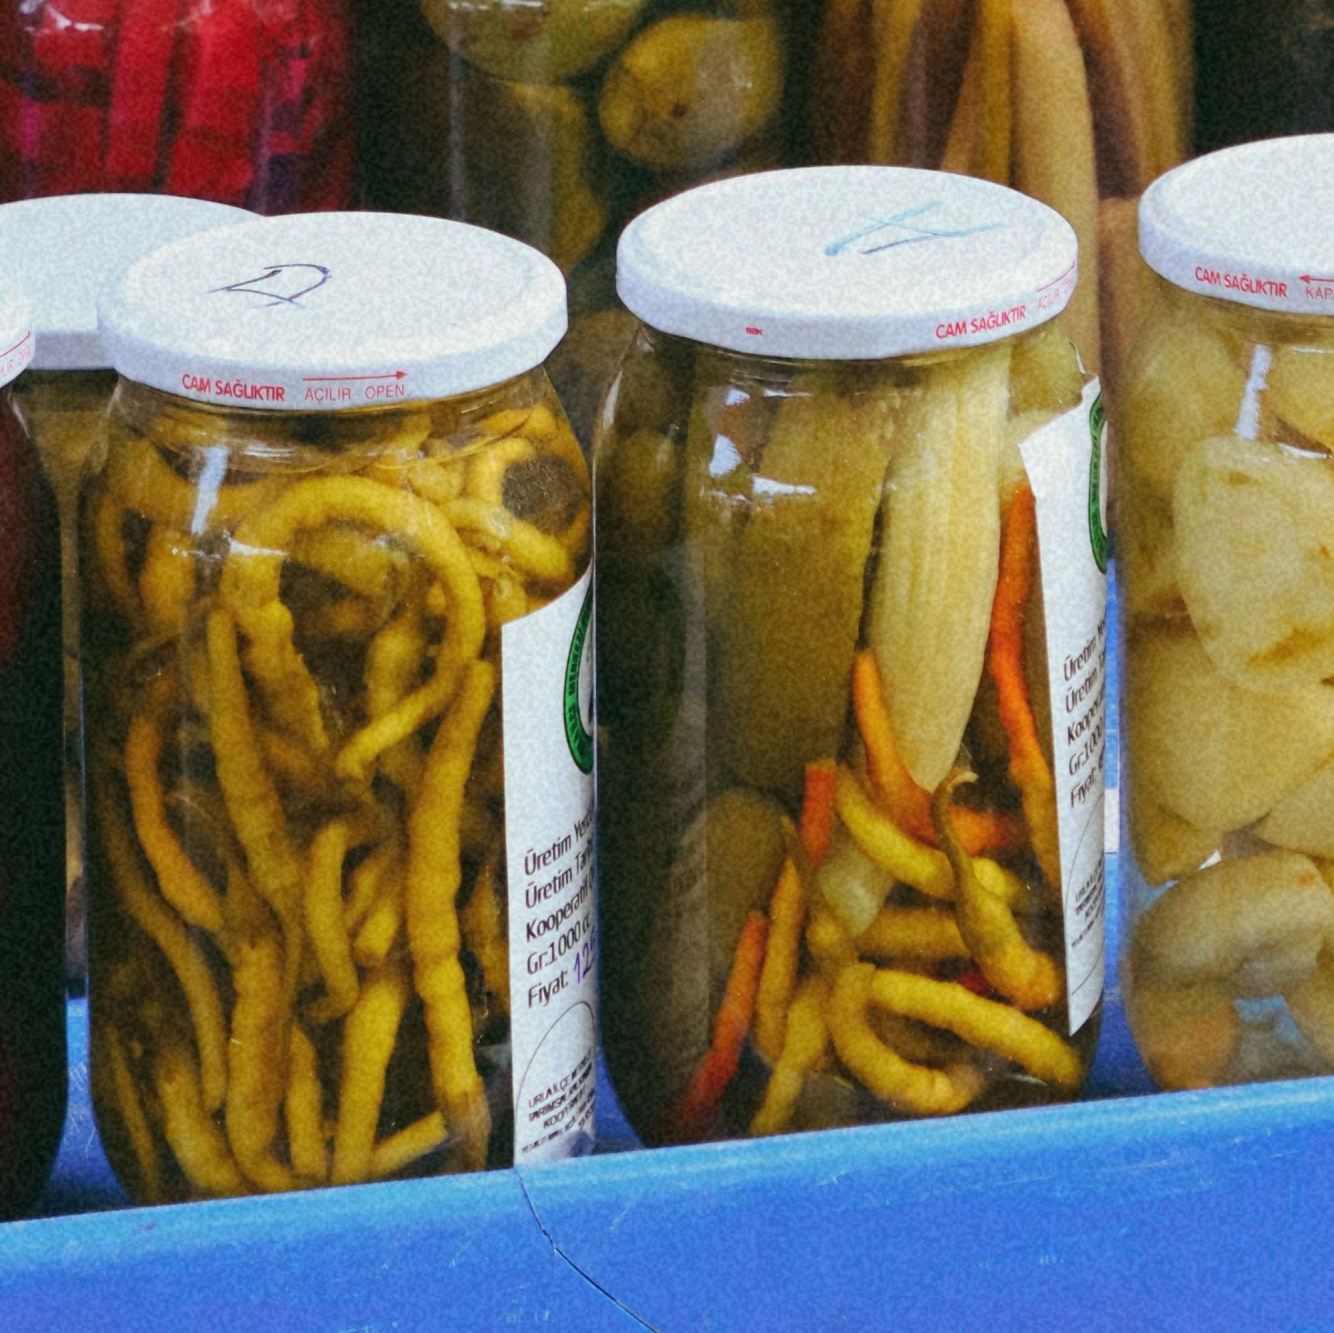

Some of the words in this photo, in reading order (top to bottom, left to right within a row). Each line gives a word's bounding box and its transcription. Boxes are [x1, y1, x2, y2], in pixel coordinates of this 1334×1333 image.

[1194, 266, 1222, 286] CAM
[1224, 273, 1289, 298] SAĞLIKTIR
[936, 321, 967, 339] CAM
[970, 304, 1027, 334] SAĞLIKTIR
[182, 374, 211, 395] CAM
[215, 378, 286, 402] SAĞLIKTIR
[304, 386, 352, 405] AÇILIR
[364, 384, 406, 400] OPEN
[1063, 634, 1097, 681] Üretim
[1065, 666, 1098, 713] Üretim
[524, 834, 572, 876] Üretim
[525, 867, 573, 909] Üretim
[526, 874, 589, 943] Kooperatif
[528, 969, 569, 1009] Fiyat:
